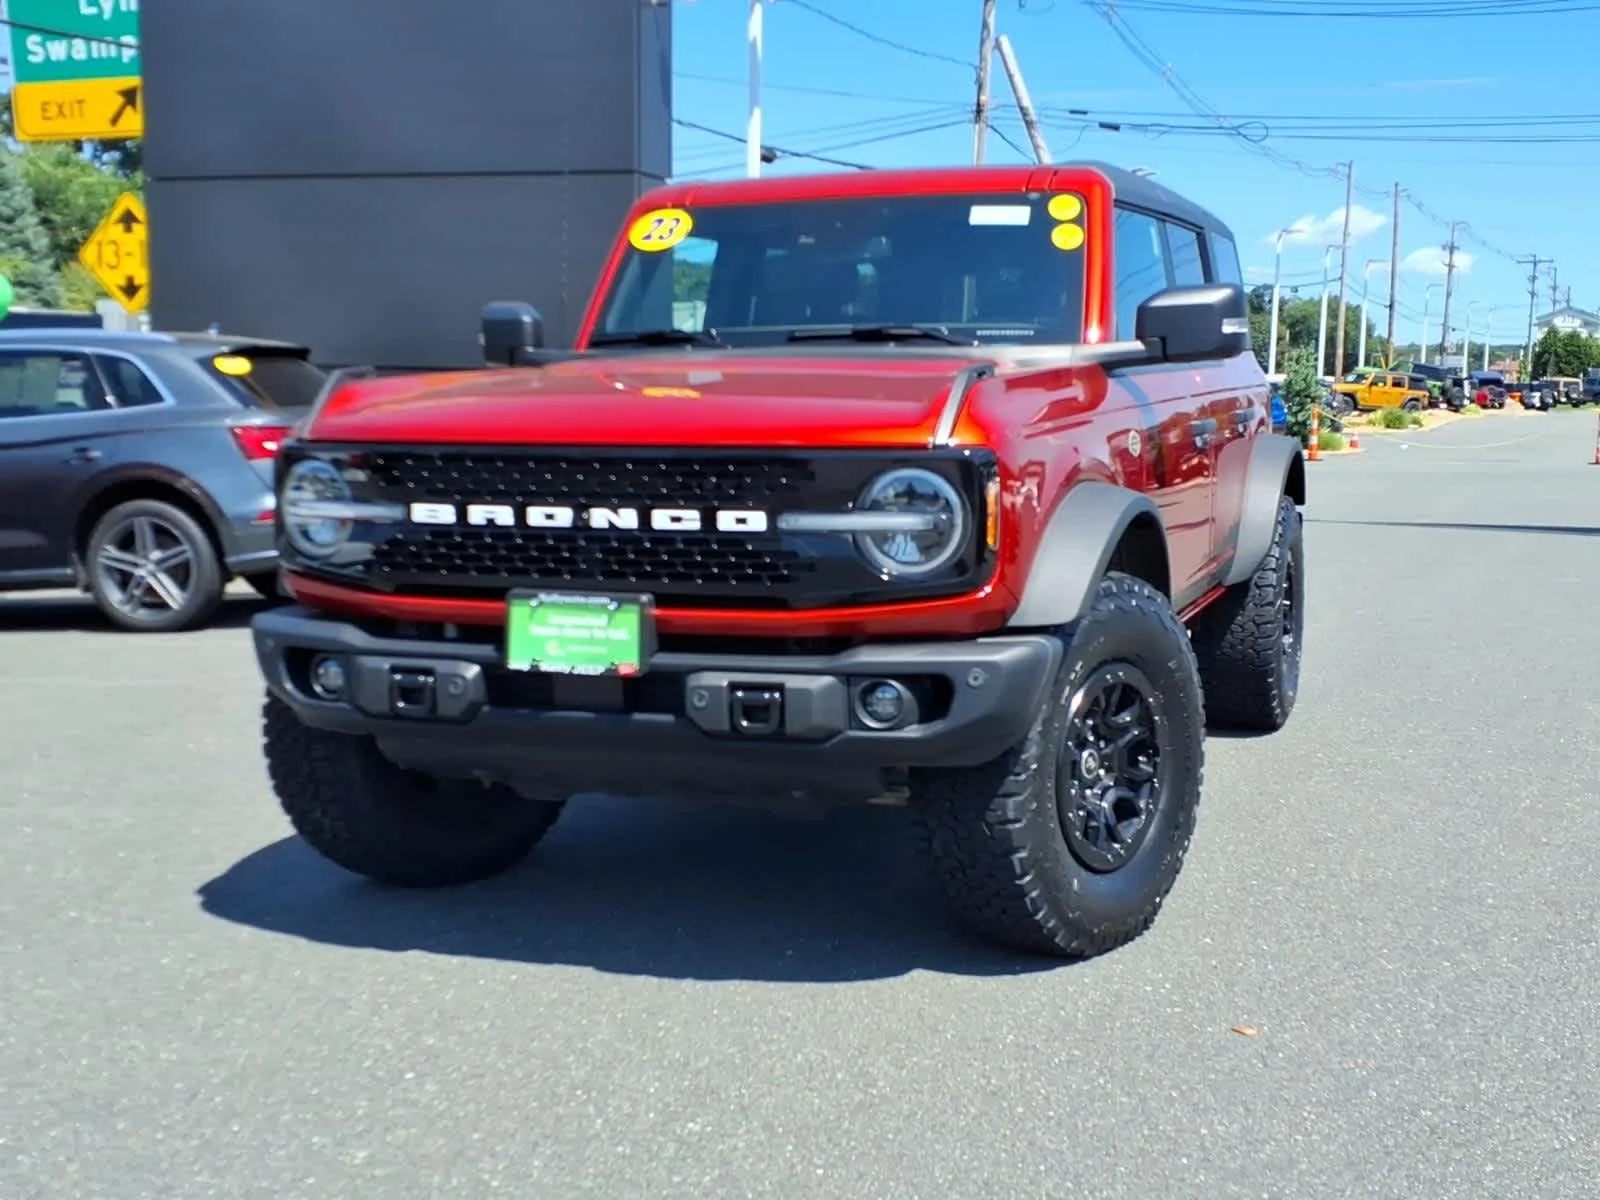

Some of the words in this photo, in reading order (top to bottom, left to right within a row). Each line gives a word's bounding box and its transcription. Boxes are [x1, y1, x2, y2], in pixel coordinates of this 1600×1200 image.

[41, 100, 86, 121] EXIT
[641, 217, 681, 241] 23
[410, 502, 767, 532] BRONCO
